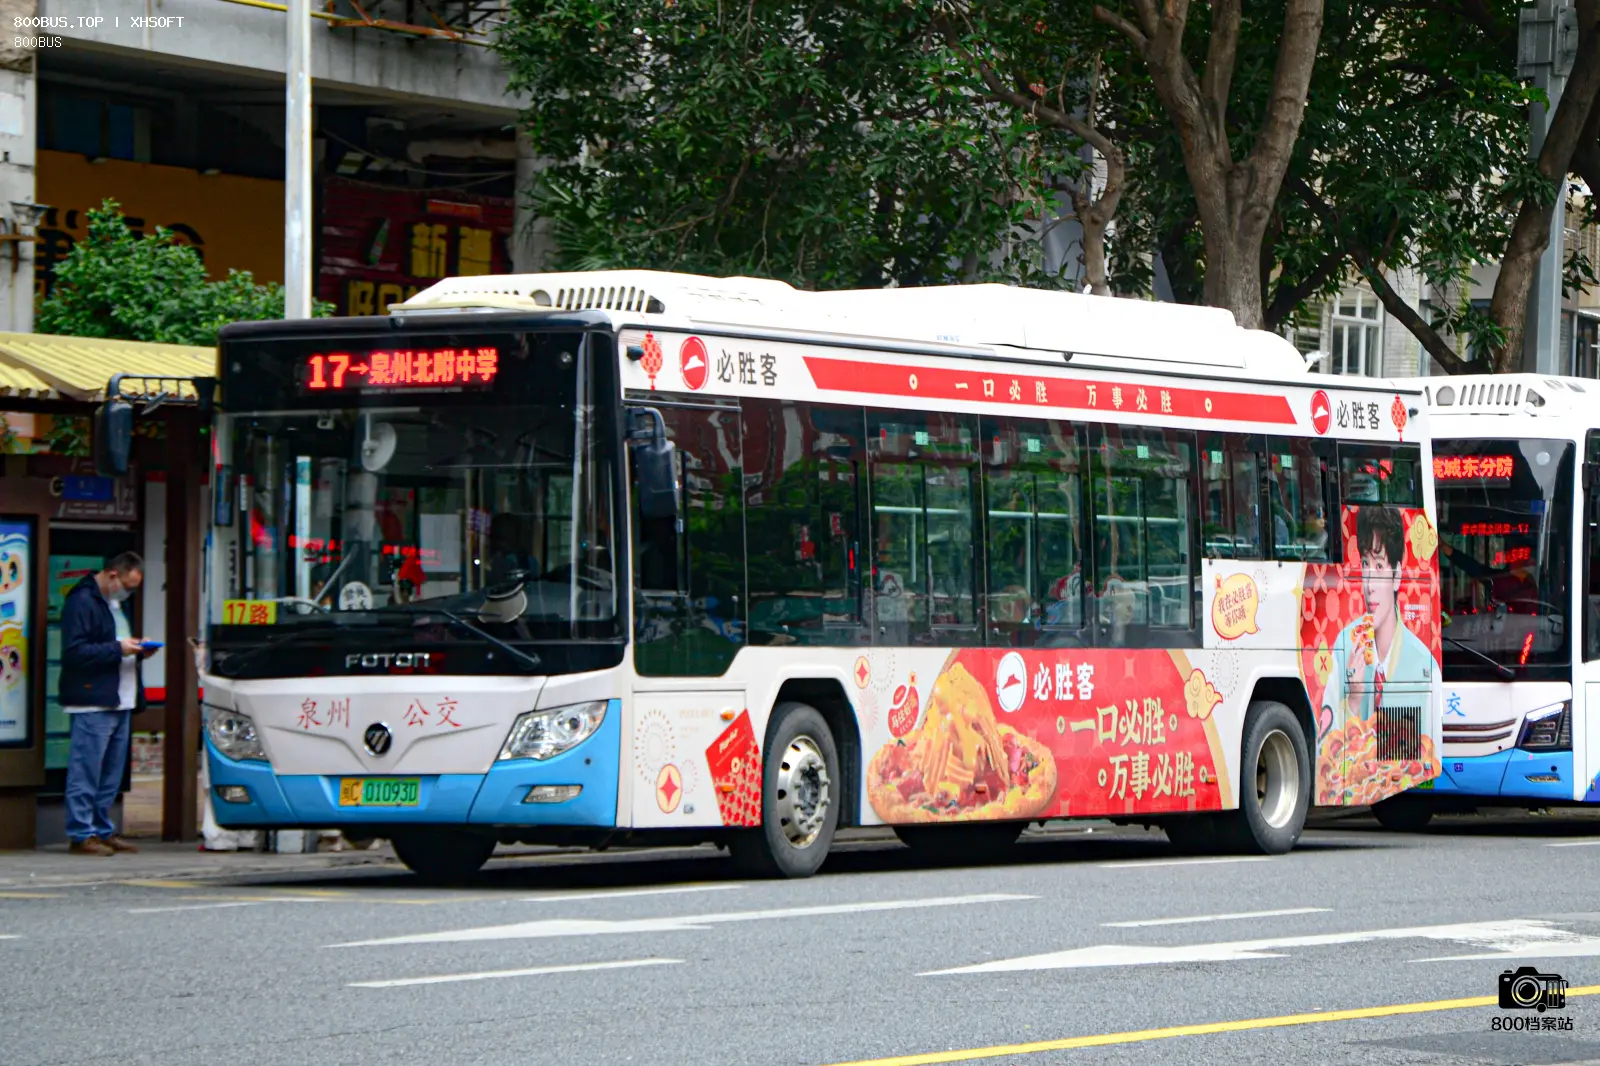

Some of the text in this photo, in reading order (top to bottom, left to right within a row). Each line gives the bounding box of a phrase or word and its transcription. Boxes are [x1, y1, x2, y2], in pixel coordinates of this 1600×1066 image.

[309, 348, 497, 388] 17 泉州北附中学
[716, 348, 778, 387] 必胜客
[955, 379, 1172, 413] 一口必胜 万事必胜
[1336, 400, 1380, 430] 必胜客
[345, 652, 430, 668] FOTON
[1033, 662, 1095, 701] 必胜客
[297, 696, 462, 729] 泉州 公交
[1069, 697, 1167, 747] 一口必胜
[1446, 692, 1465, 717] 交
[1109, 751, 1196, 800] 万事必胜
